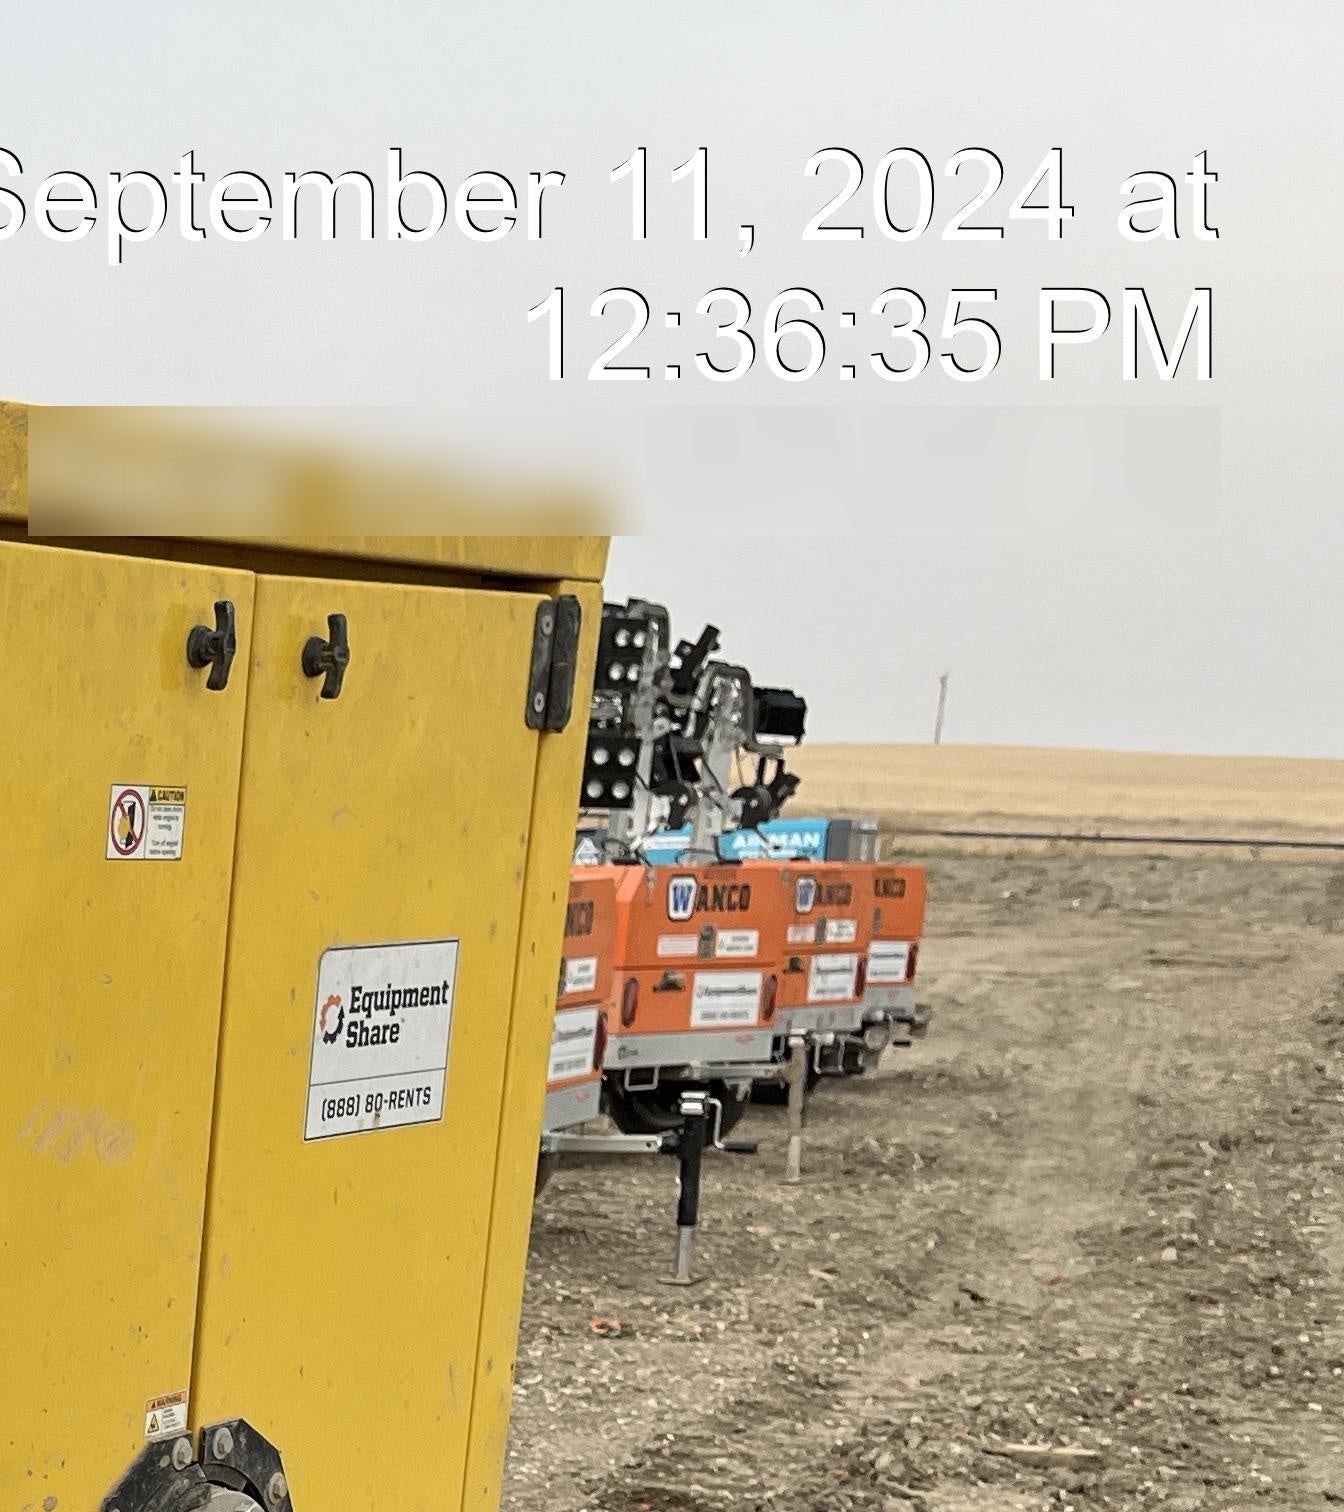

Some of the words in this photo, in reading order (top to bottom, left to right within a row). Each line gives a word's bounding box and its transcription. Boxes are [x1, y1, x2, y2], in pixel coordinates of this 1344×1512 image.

[157, 789, 185, 802] CAUTION
[673, 884, 751, 912] WANCO
[873, 878, 906, 899] ANCO
[348, 980, 449, 1018] Equipment
[346, 1020, 400, 1048] Share
[321, 1093, 361, 1122] (888)
[364, 1086, 432, 1114] 80-RENTS
